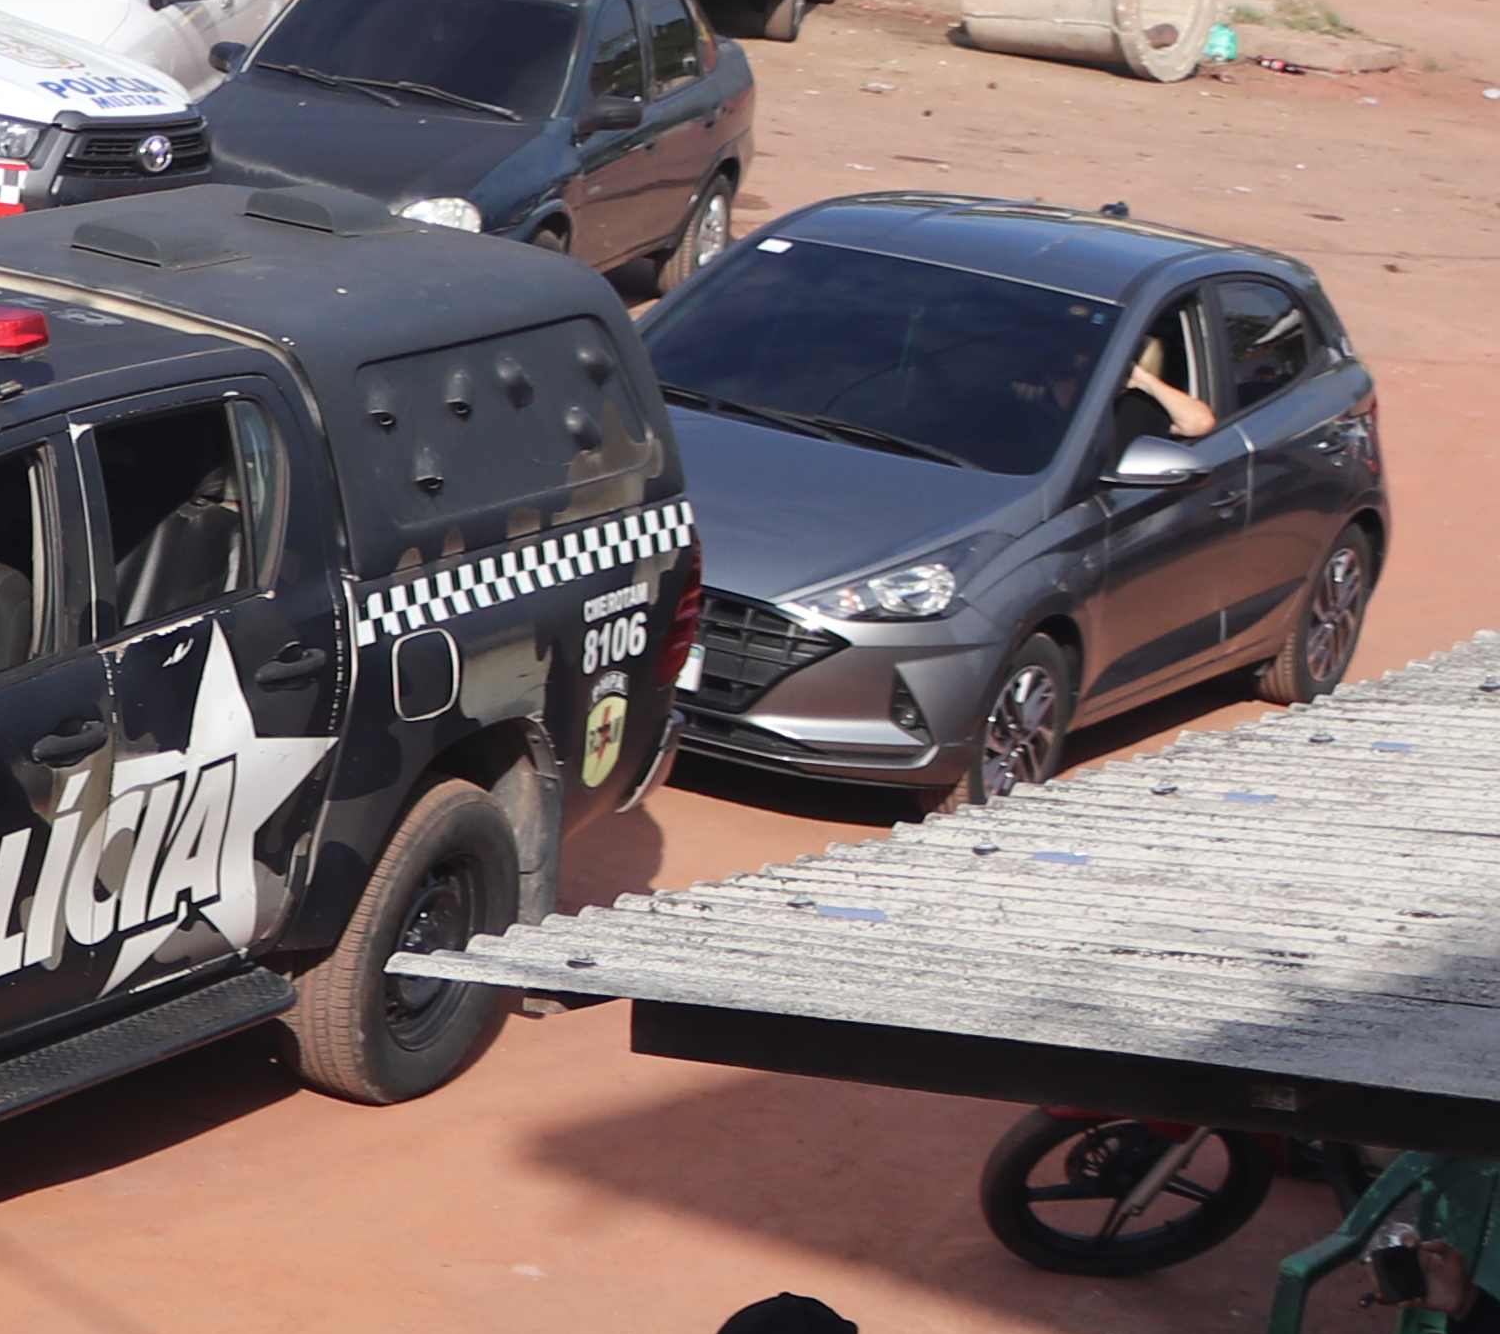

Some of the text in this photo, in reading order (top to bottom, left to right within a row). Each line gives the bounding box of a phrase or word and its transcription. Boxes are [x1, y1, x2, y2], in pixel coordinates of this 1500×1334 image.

[37, 71, 171, 99] POLÍCIA
[90, 94, 168, 110] MILITAR
[582, 610, 649, 675] 8106
